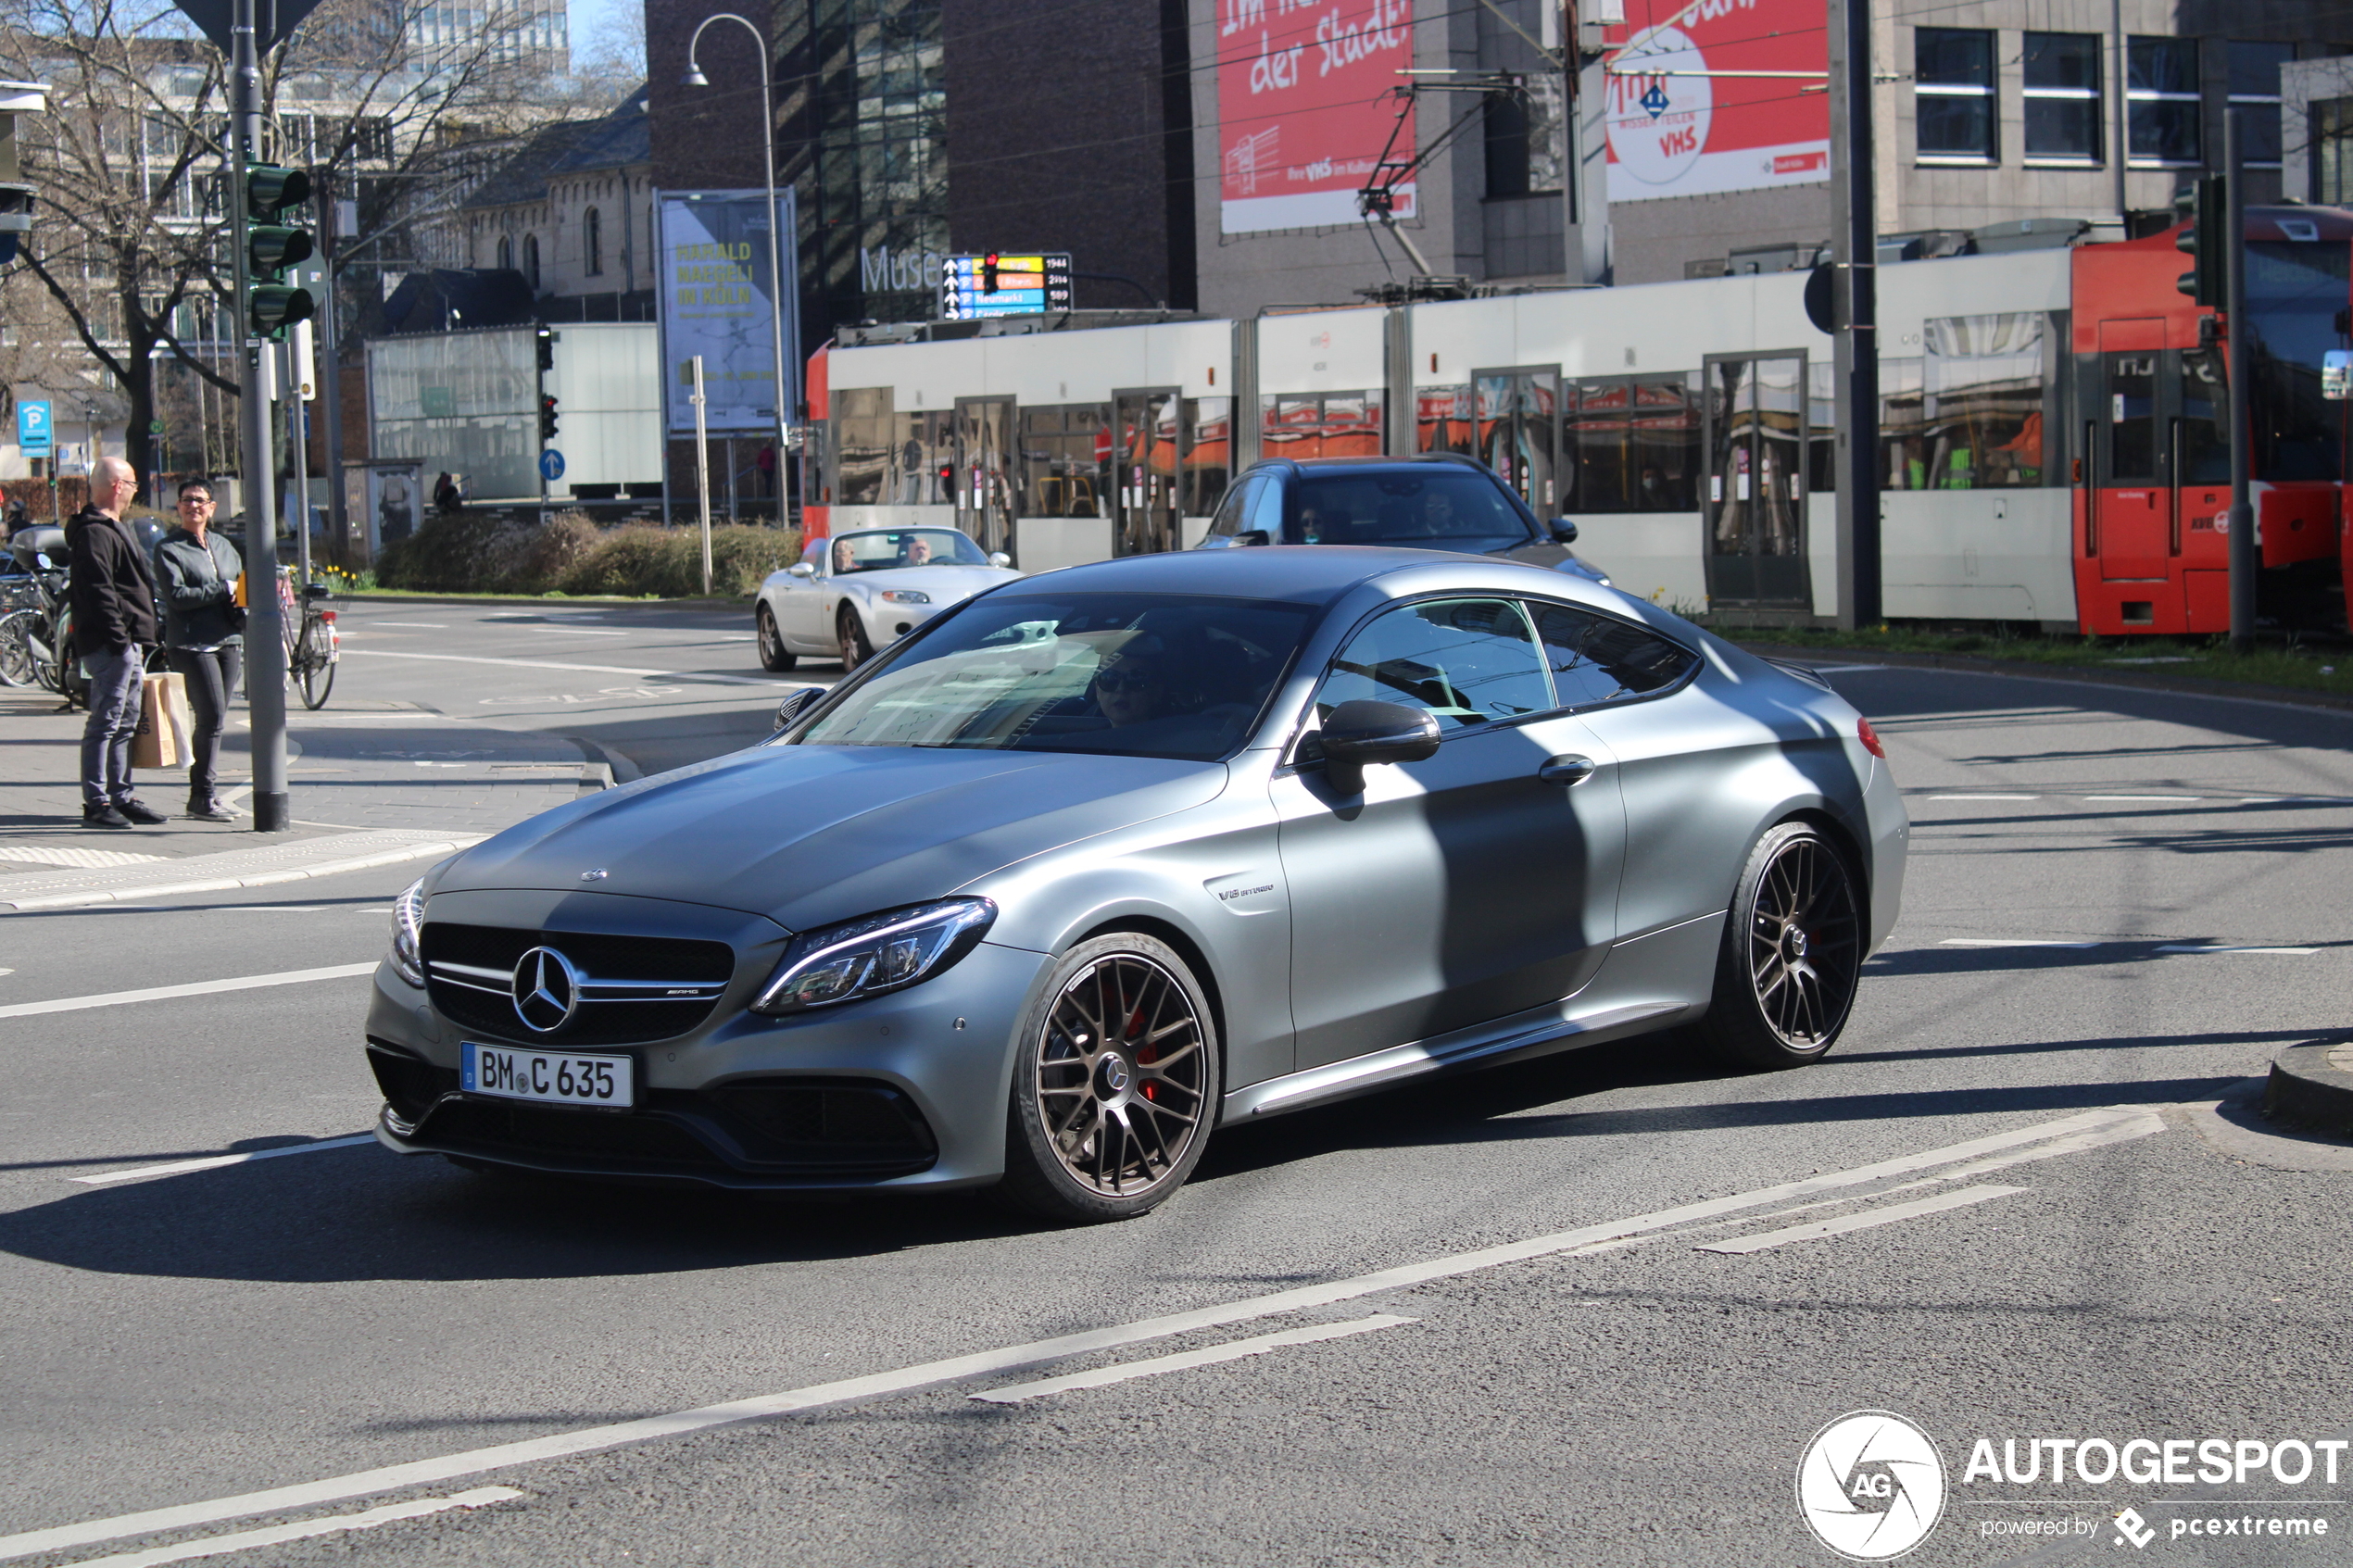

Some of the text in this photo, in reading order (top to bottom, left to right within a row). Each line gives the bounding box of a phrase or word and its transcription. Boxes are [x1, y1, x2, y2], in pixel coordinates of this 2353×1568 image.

[1252, 0, 1407, 94] der Stadt!
[1659, 125, 1697, 158] VHS
[1288, 166, 1305, 181] Ihre
[1305, 157, 1333, 182] VHS
[676, 243, 751, 261] HARALD
[677, 264, 753, 283] NAEGELI
[678, 282, 750, 305] IN KÖLN
[975, 293, 1024, 304] Neumarkt
[2191, 517, 2214, 530] KVB
[1218, 889, 1239, 901] V8
[467, 1050, 614, 1099] D BM C 635
